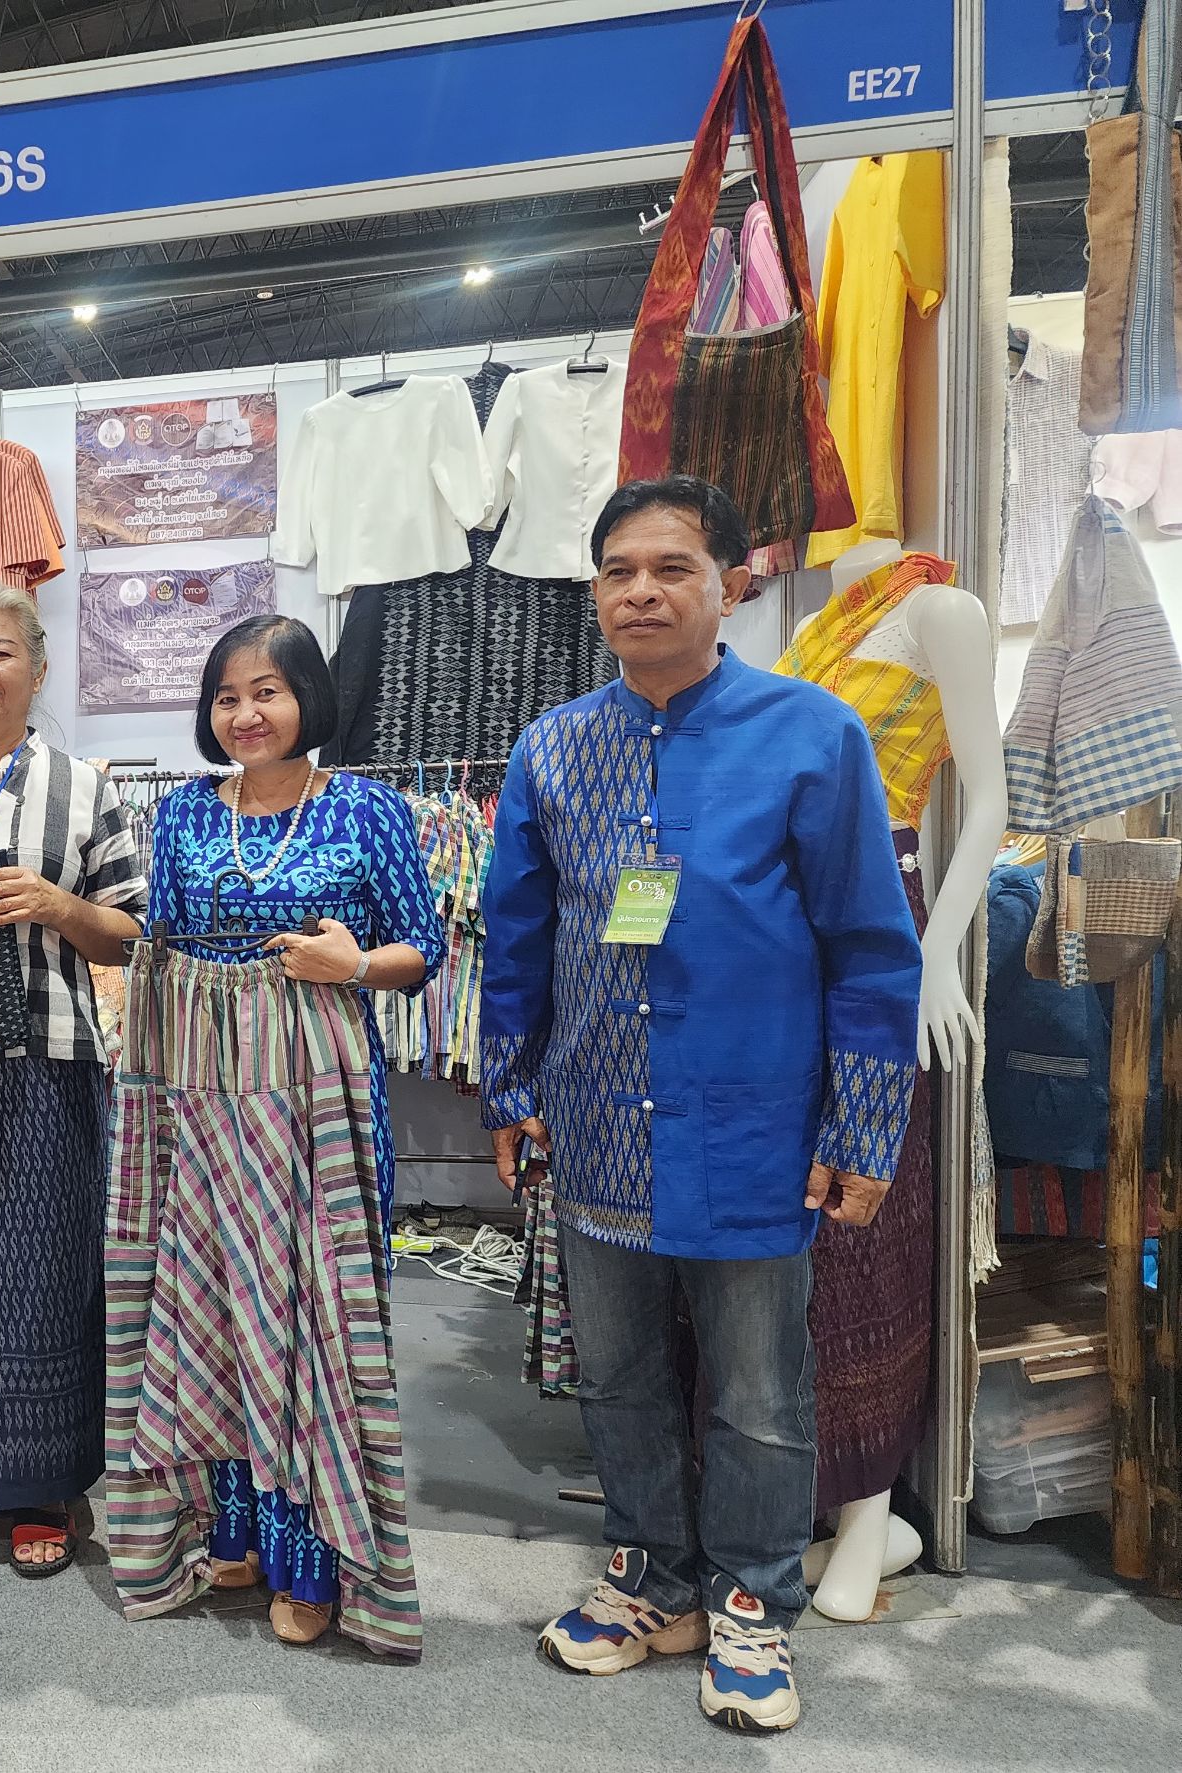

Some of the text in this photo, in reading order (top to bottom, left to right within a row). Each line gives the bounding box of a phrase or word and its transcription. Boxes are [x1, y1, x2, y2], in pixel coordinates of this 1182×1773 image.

[848, 64, 921, 102] EE27
[163, 423, 188, 432] OTOP
[148, 492, 162, 509] หมู่
[163, 495, 170, 505] 4
[197, 506, 227, 521] จ.ยโสธร
[184, 587, 206, 595] OTOP
[617, 914, 659, 923] ผู้ประกอบการ
